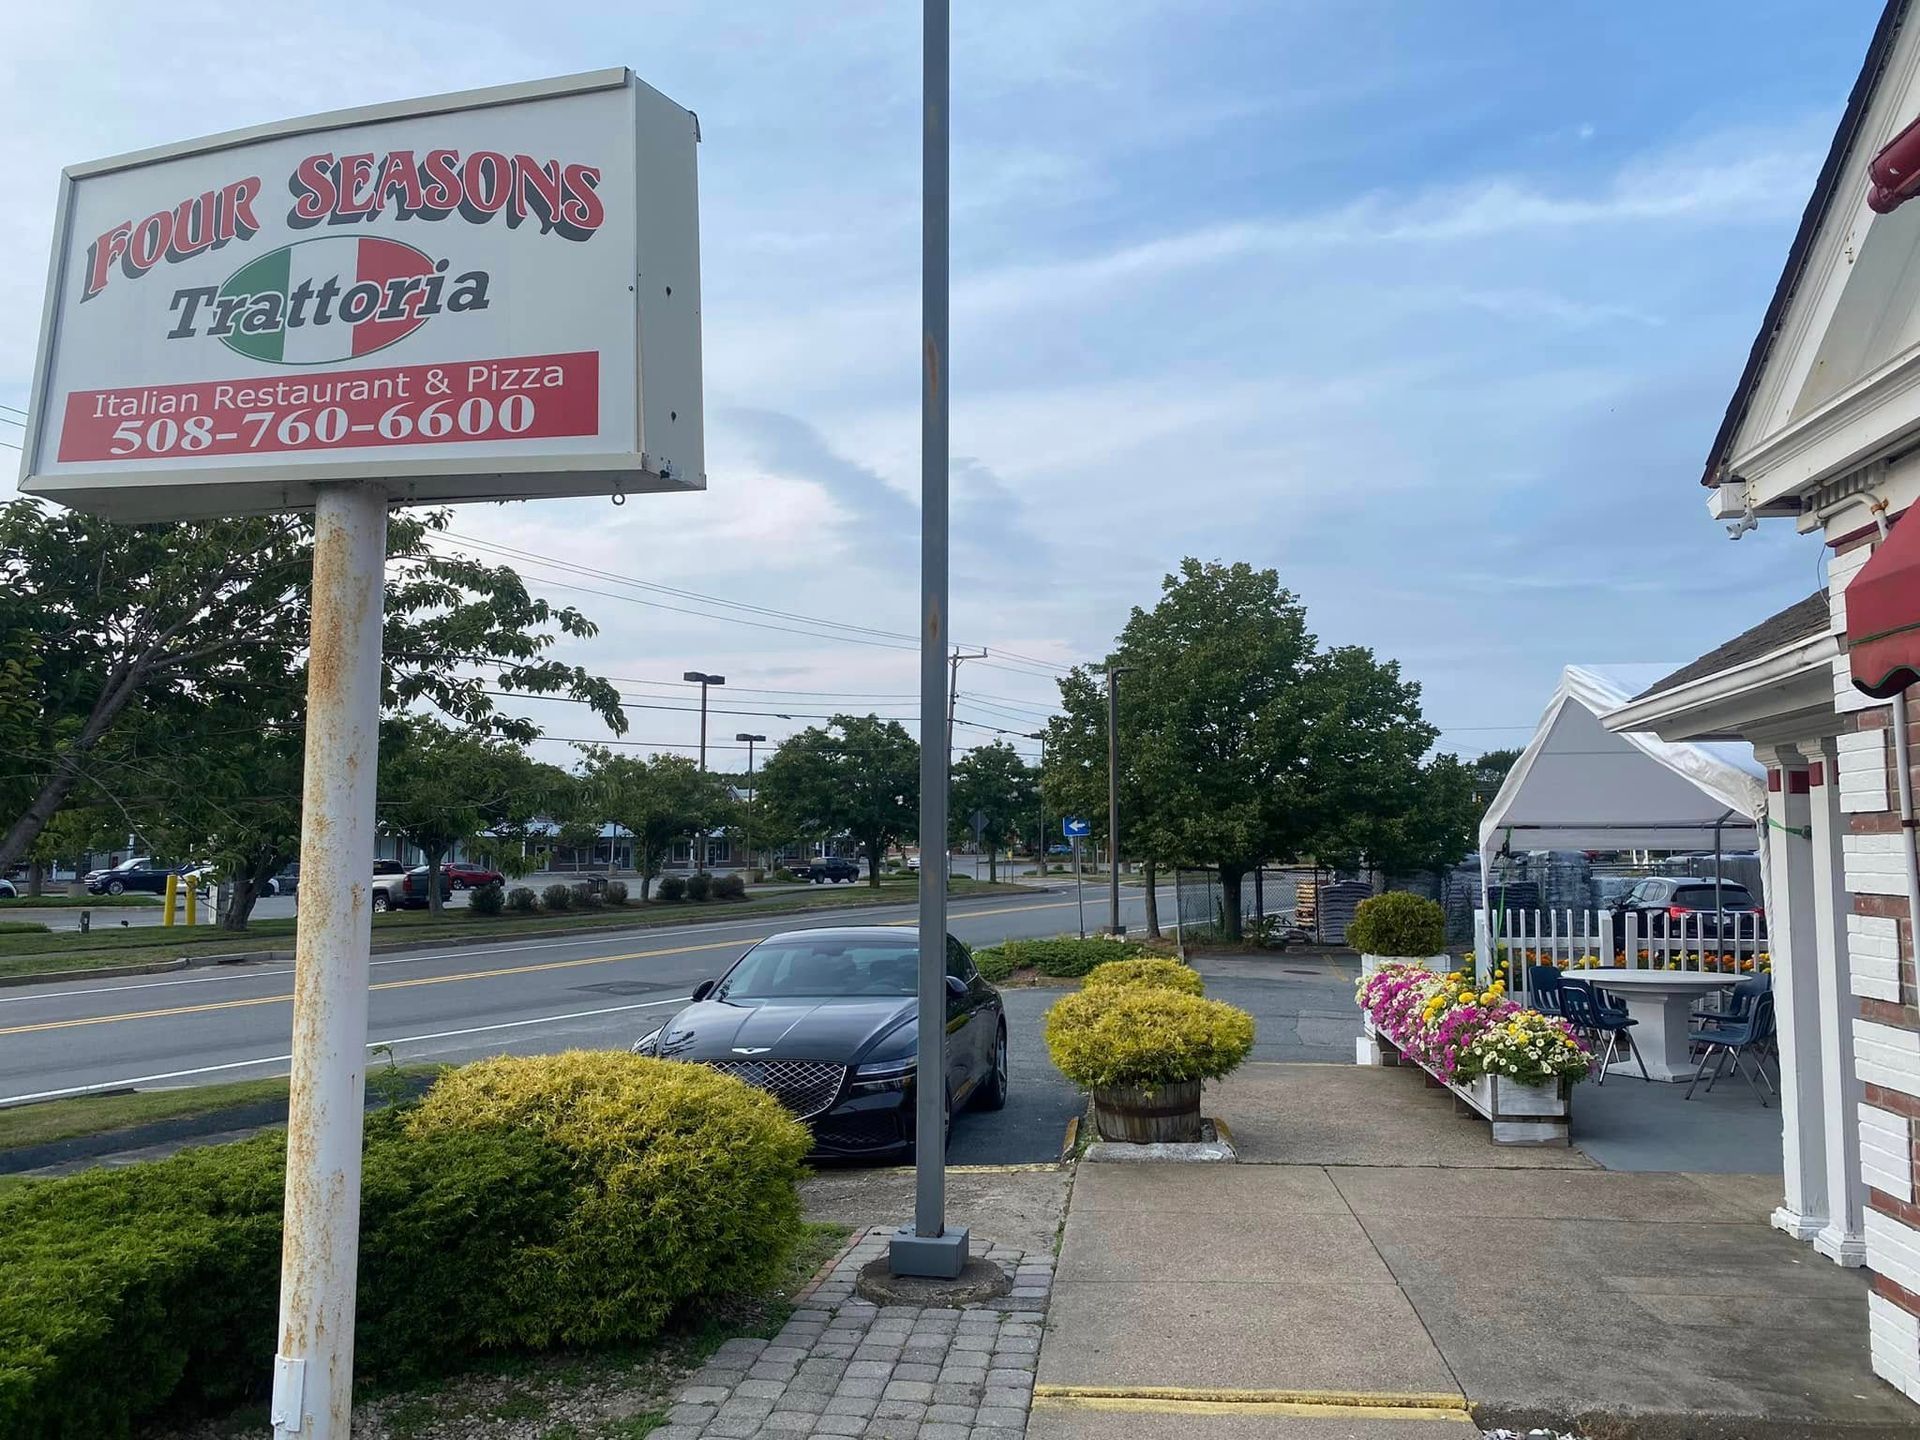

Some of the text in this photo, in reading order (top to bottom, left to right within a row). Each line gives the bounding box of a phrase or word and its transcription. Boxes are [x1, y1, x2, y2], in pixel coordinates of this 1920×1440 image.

[80, 149, 605, 304] FOUR SEASONS
[167, 258, 490, 339] Trattoria
[92, 364, 564, 418] Italian Restaurant & Pizza
[110, 394, 536, 455] 508-760-6600
